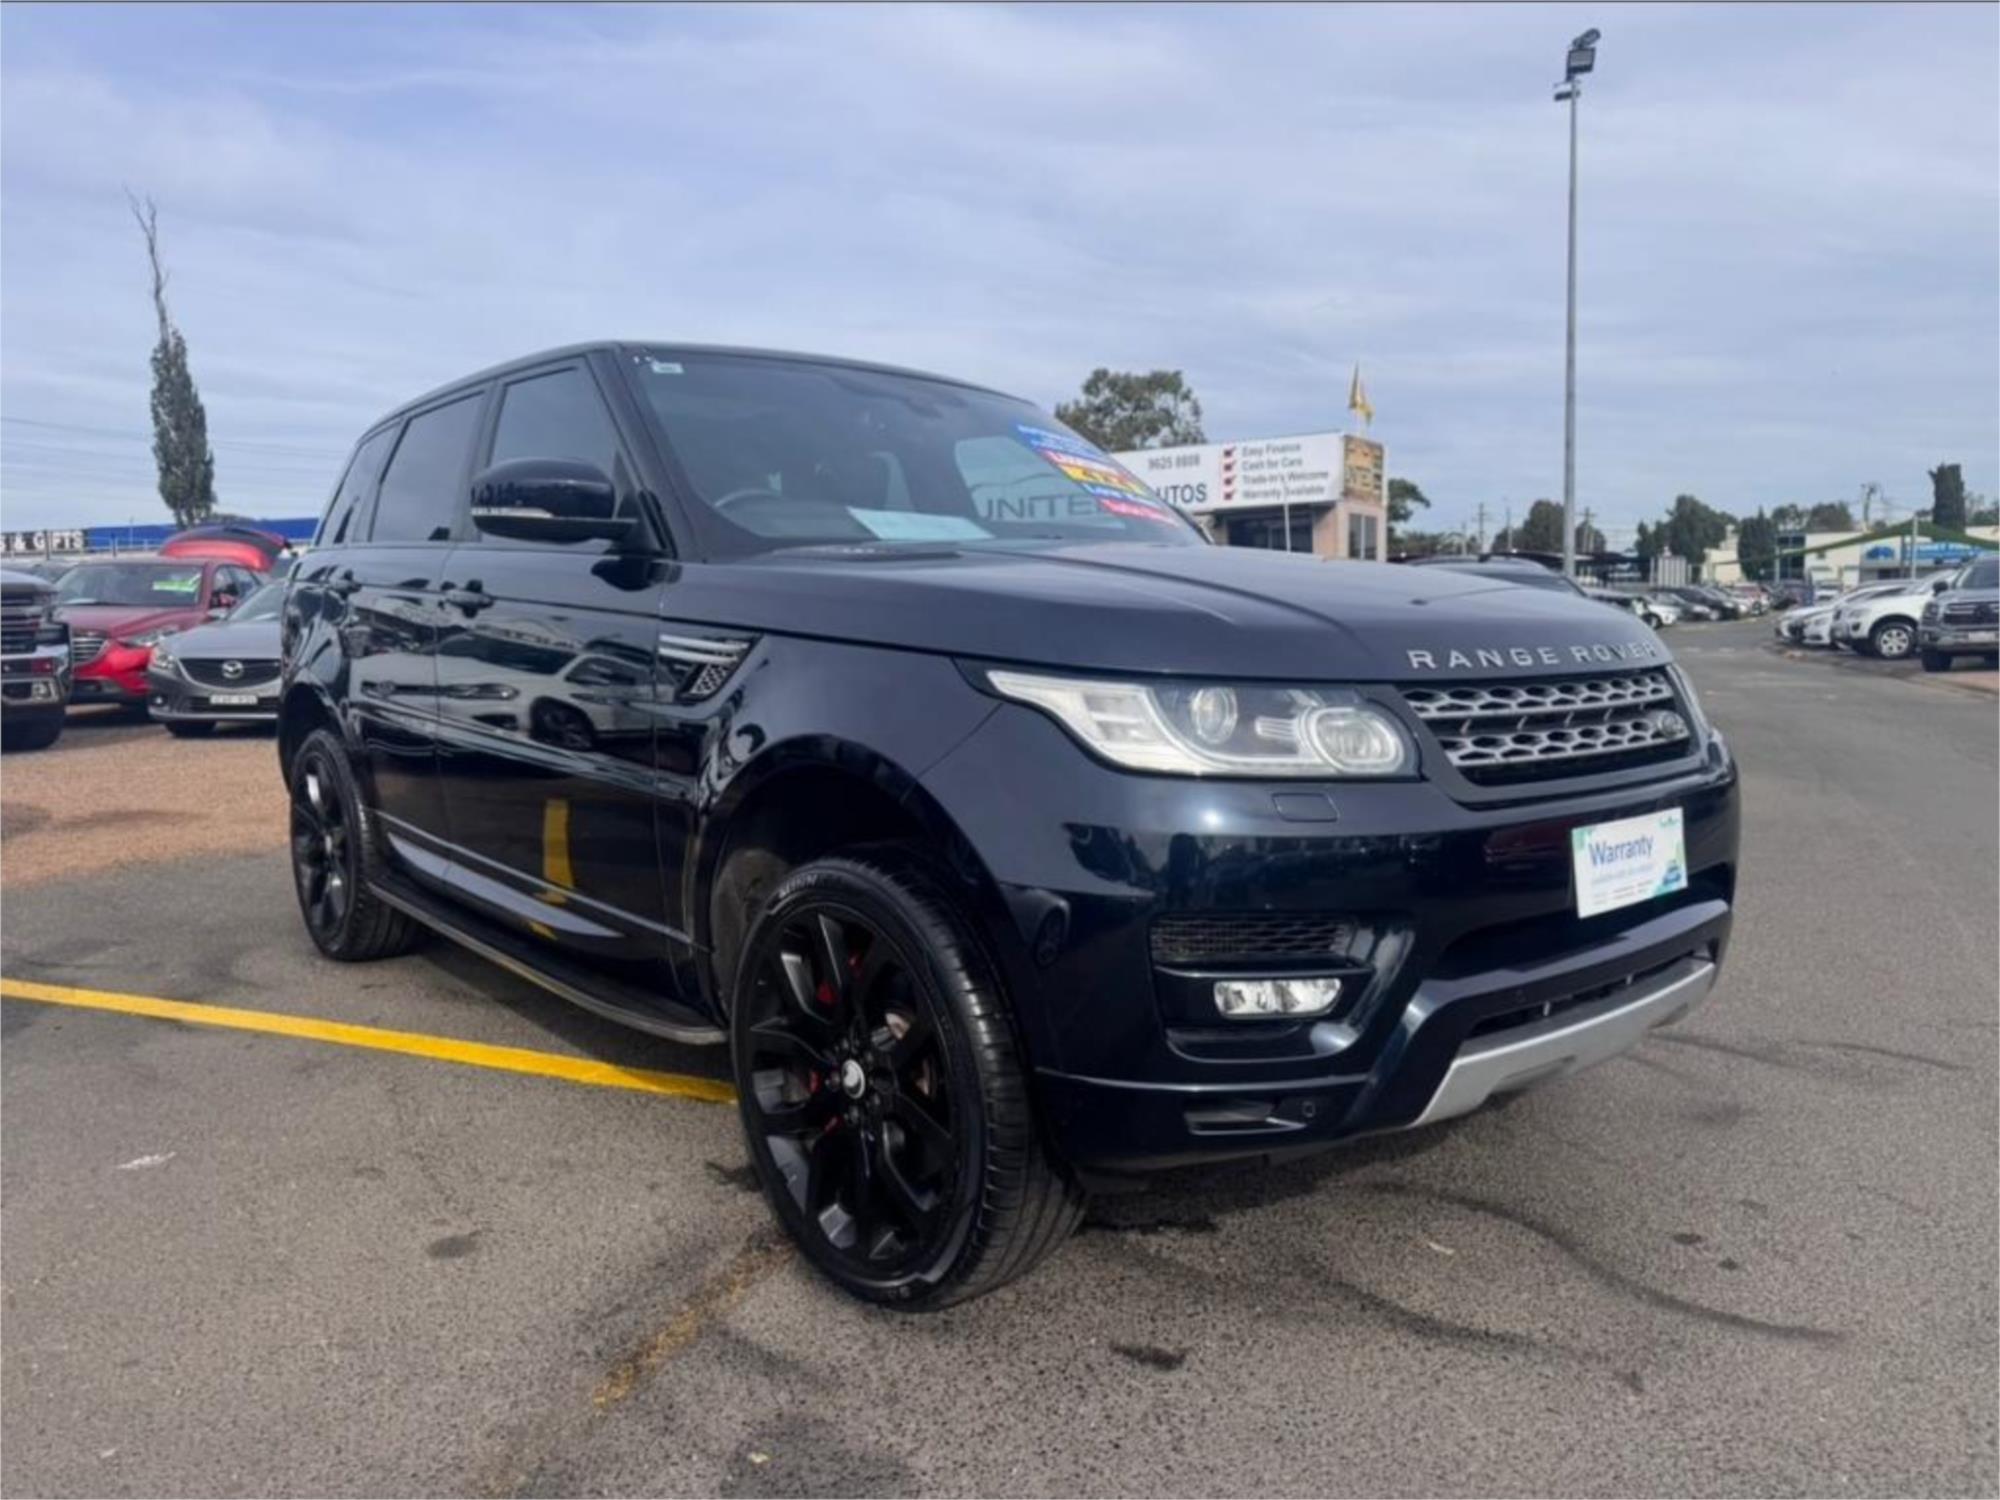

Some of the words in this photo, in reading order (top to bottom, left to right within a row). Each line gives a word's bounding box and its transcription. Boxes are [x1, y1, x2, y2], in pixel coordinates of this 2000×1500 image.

[1406, 647, 1559, 669] RANGE
[1569, 641, 1658, 663] ROVER
[1588, 834, 1655, 867] Warranty
